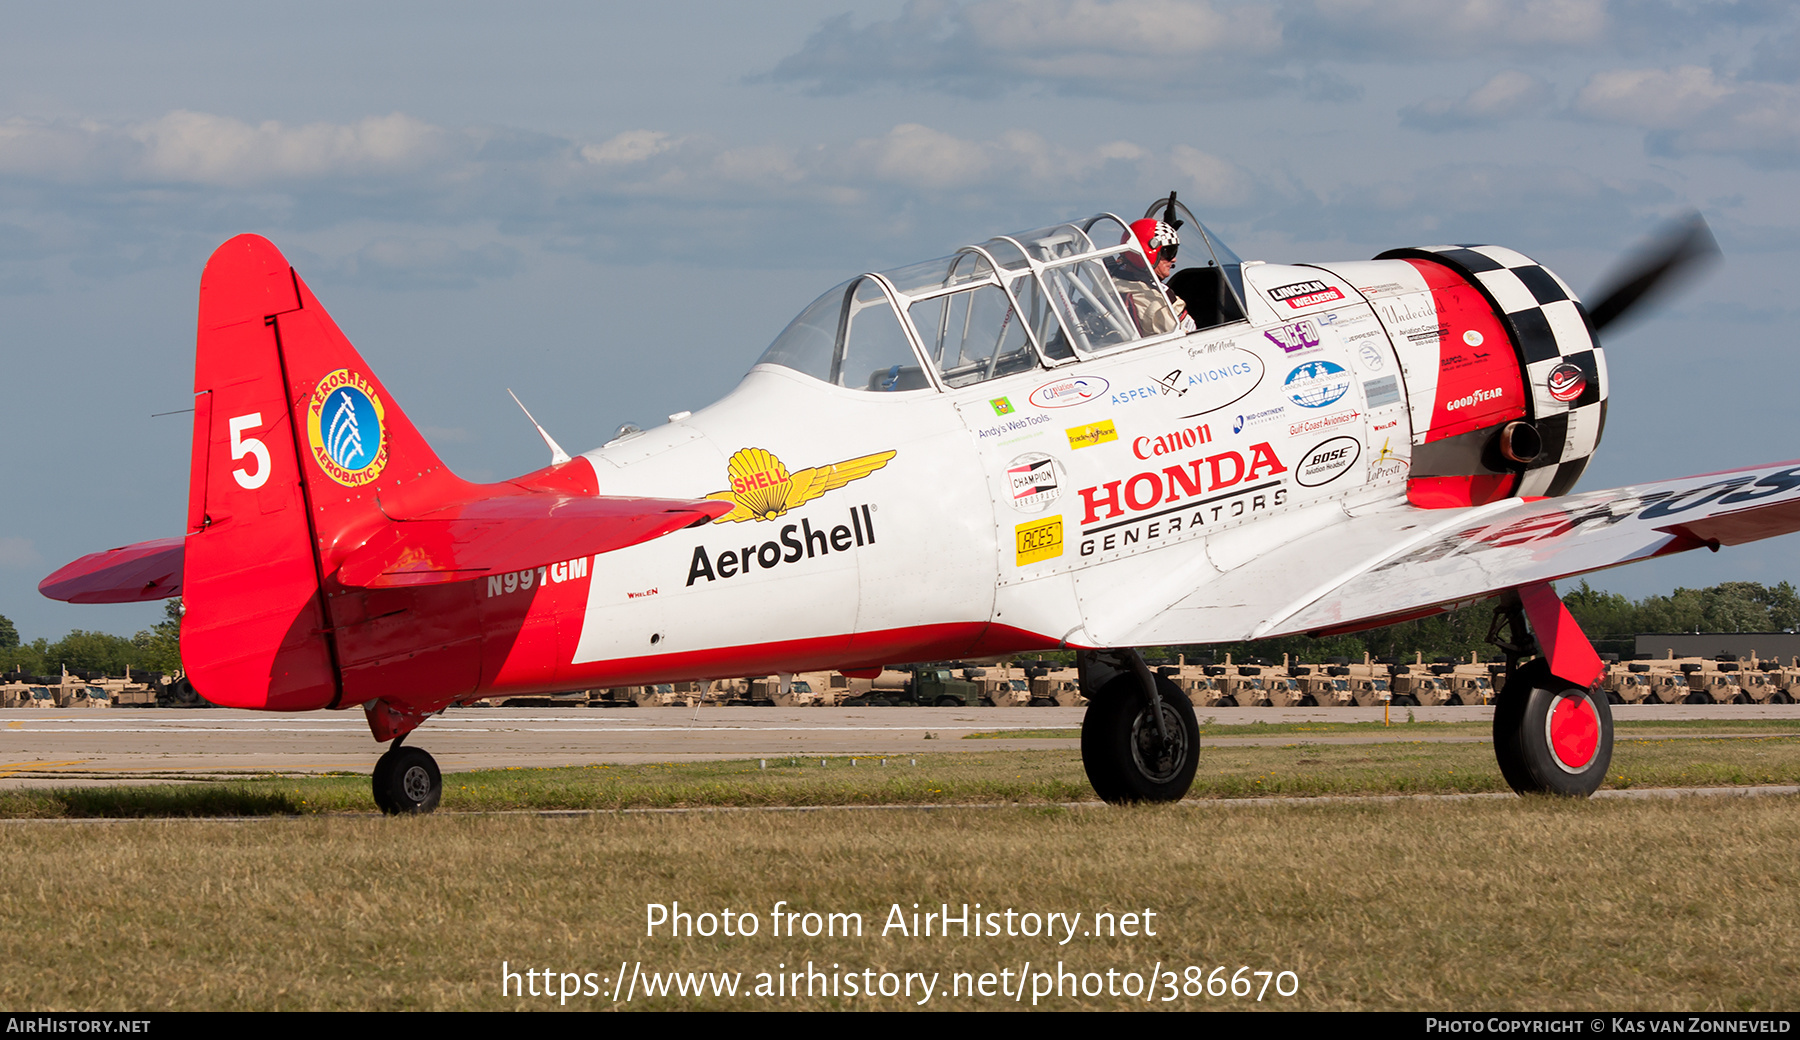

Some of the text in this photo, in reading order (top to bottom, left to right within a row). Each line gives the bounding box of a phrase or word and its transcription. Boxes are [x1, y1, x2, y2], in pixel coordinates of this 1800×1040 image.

[1270, 281, 1326, 301] LINCOLN
[1292, 290, 1339, 308] WELDERS
[1382, 297, 1447, 324] Undecided
[1348, 330, 1381, 343] JEPPESEN
[1399, 325, 1422, 336] Aviation
[1187, 347, 1204, 361] Gene
[1111, 362, 1252, 406] ASPEN AVIONICS
[1302, 377, 1325, 387] AVIATION
[1324, 371, 1351, 384] INSURANCE
[311, 371, 378, 417] AEROSHELL
[1446, 387, 1503, 411] GOODYEAR
[1246, 406, 1285, 421] MID-CONTINENT
[1289, 413, 1351, 436] Gulf Coast Avionics
[978, 425, 1007, 439] Andy's
[1006, 419, 1027, 431] Web
[229, 412, 271, 490] 5
[1132, 423, 1212, 460] Canon
[314, 429, 389, 484] AEROBATIC TEAM
[1305, 459, 1346, 476] Aviation Headset
[1312, 448, 1349, 466] BOSE
[733, 467, 788, 495] SHELL
[1013, 470, 1053, 489] CHAMPION
[1077, 441, 1288, 526] HONDA
[1367, 462, 1401, 483] LoPresti
[1014, 490, 1060, 507] AEROSPACE
[1080, 488, 1288, 557] GENERATORS
[685, 503, 876, 587] AeroShell
[1022, 526, 1053, 550] ACES
[487, 556, 588, 598] N991GM
